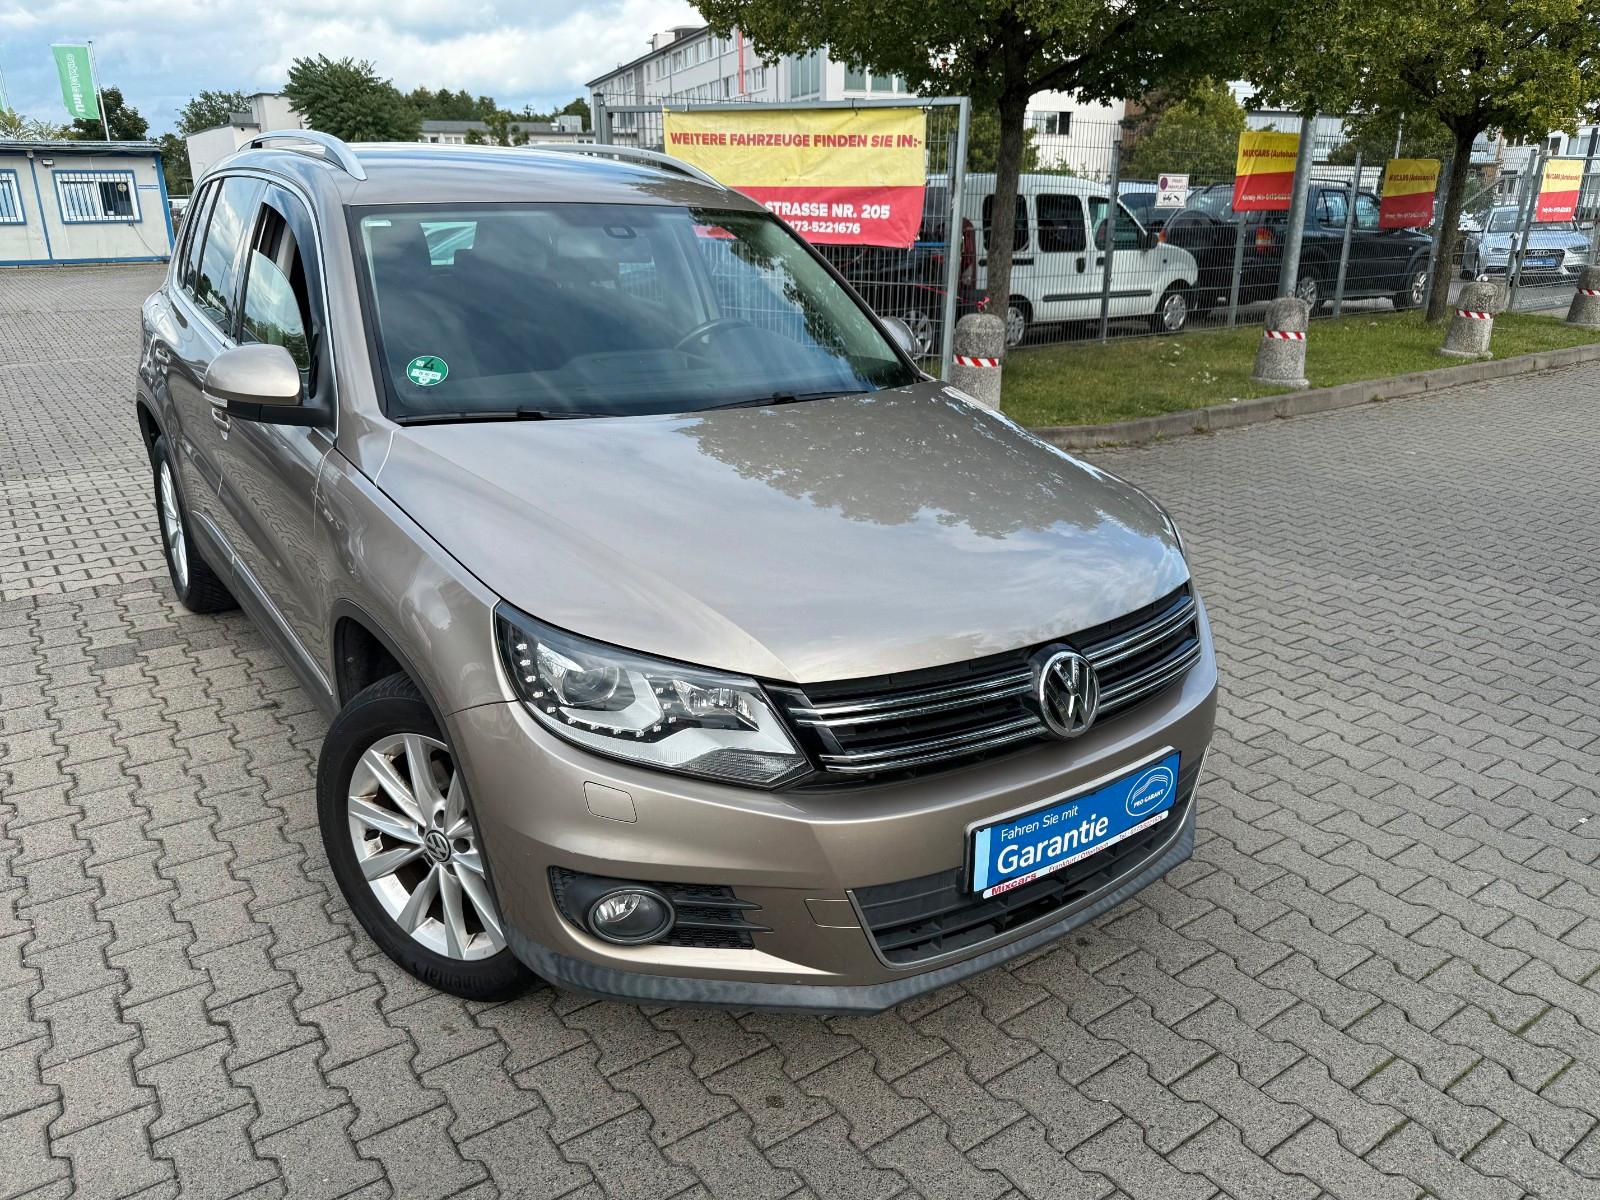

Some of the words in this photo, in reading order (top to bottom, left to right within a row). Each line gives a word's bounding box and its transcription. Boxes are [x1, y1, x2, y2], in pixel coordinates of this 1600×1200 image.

[670, 132, 726, 146] WEITERE
[730, 133, 810, 147] FAHRZEUGE
[814, 134, 868, 147] FINDEN
[871, 134, 893, 148] SIE
[764, 201, 828, 217] STRASSE
[831, 203, 858, 218] NR.
[861, 204, 891, 219] 205
[423, 358, 434, 371] 4
[1134, 799, 1144, 808] PRO
[1001, 821, 1039, 842] Fahren
[1042, 814, 1059, 827] Sie
[1061, 805, 1079, 821] mit
[997, 813, 1109, 874] Garantie
[991, 872, 1037, 896] Mixcars
